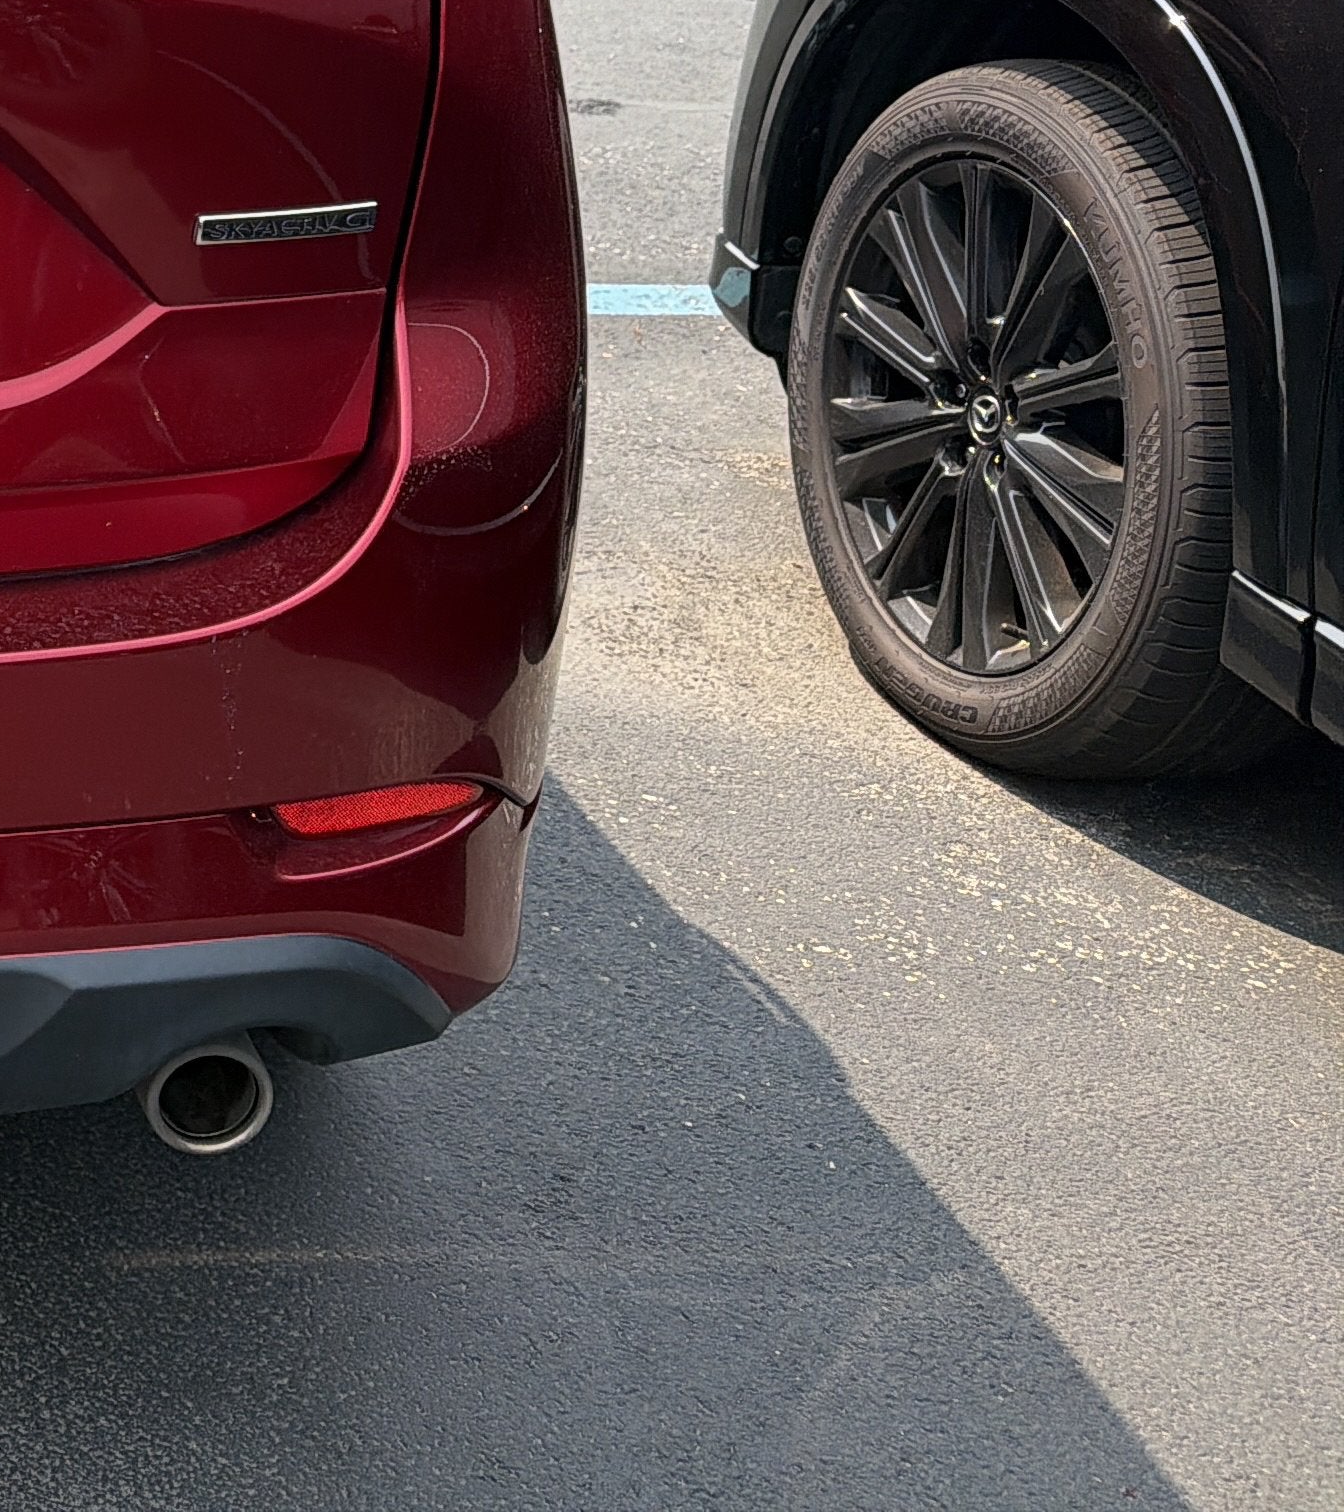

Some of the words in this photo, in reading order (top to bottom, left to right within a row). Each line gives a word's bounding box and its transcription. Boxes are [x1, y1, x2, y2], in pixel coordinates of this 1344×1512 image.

[209, 214, 340, 240] SKYACTIV
[1083, 196, 1148, 369] KUMHO
[873, 656, 979, 725] CRUGEN
